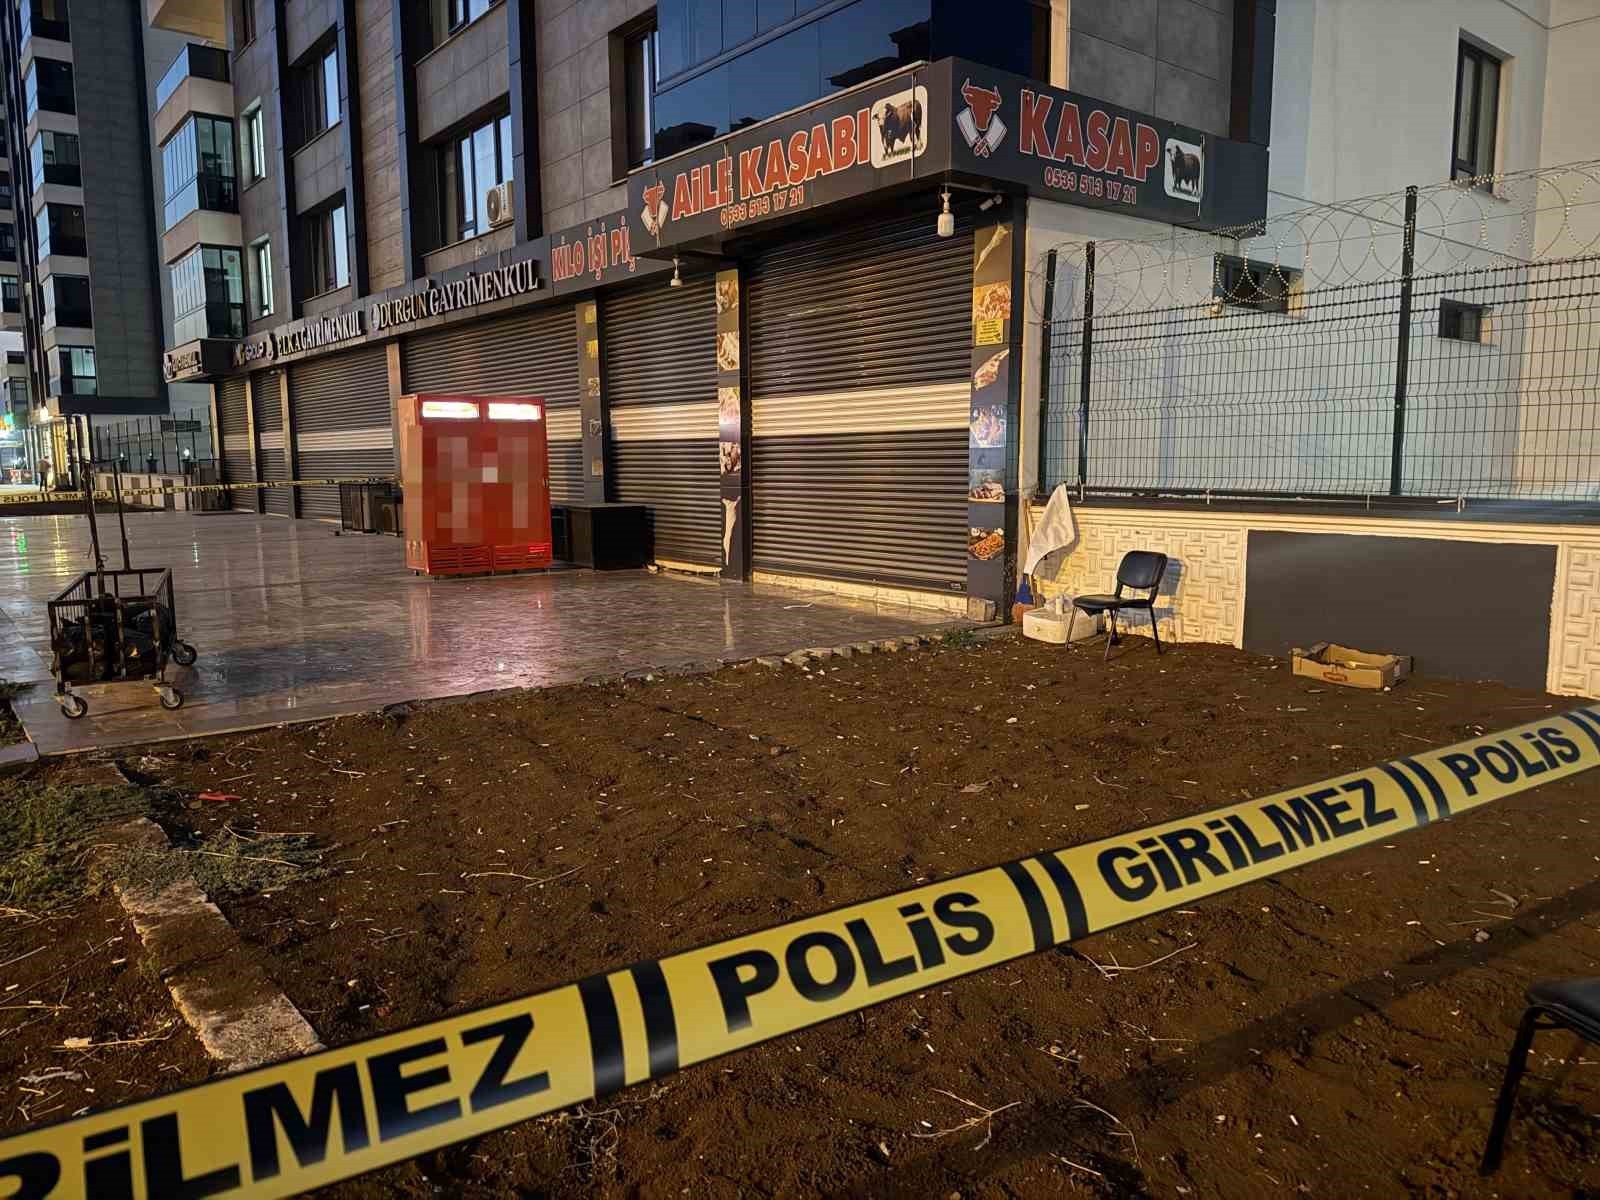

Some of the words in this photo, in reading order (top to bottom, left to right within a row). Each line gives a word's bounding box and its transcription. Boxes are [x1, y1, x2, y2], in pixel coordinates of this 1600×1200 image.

[739, 107, 871, 201] KASABI
[1019, 88, 1160, 182] KASAP
[720, 203, 748, 227] 0533
[748, 195, 771, 218] 513
[772, 190, 788, 212] 17
[789, 184, 805, 208] 21
[1043, 166, 1077, 191] 0533
[1079, 173, 1104, 197] 513
[1106, 180, 1122, 201] 17
[1121, 184, 1138, 205] 21
